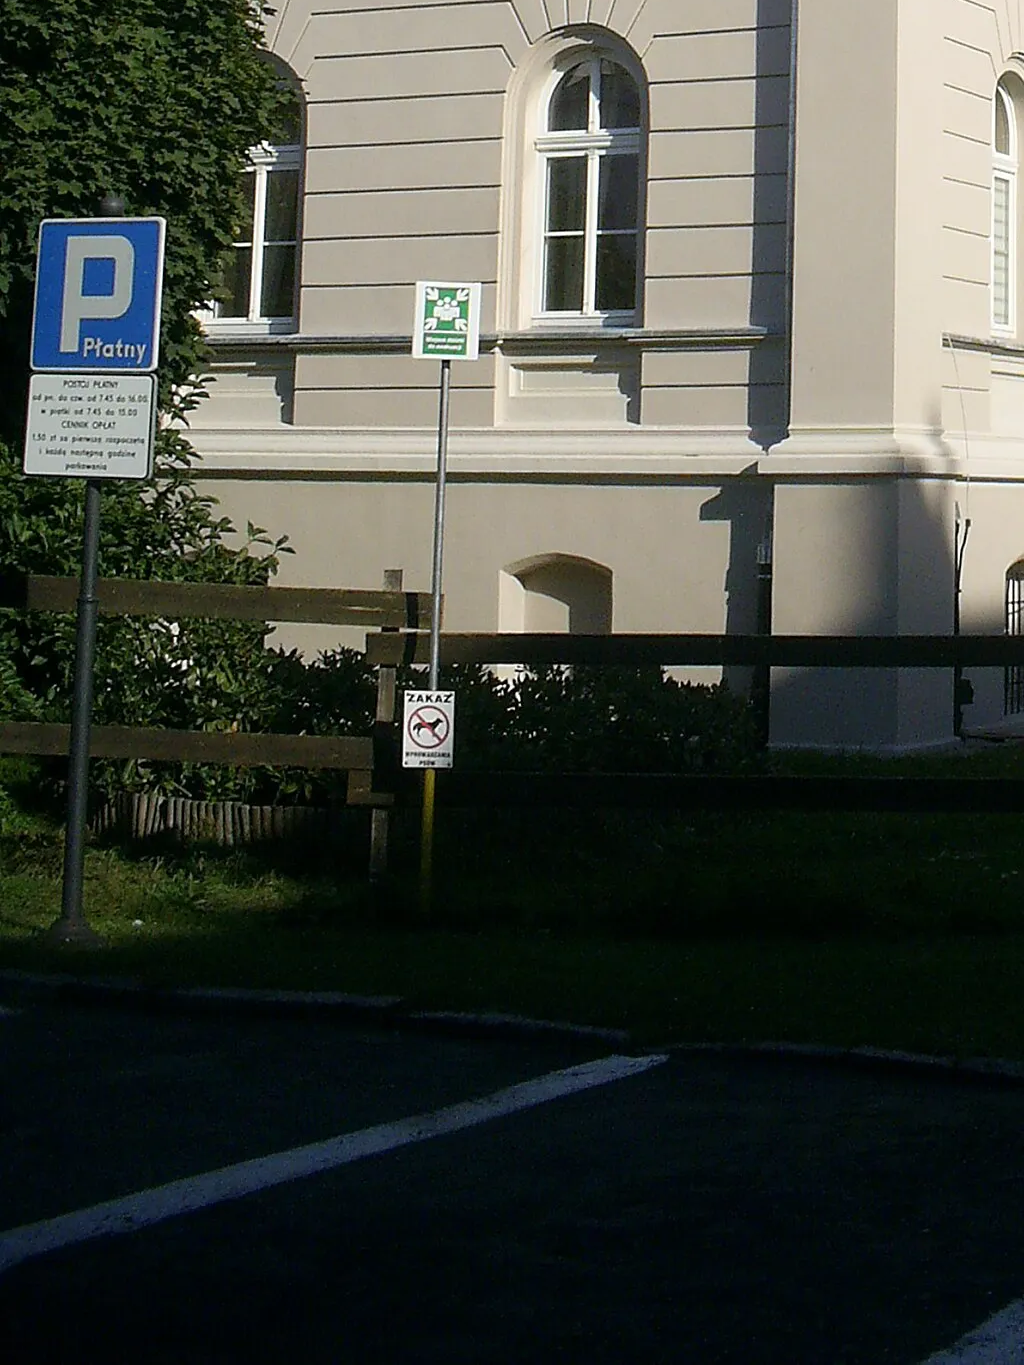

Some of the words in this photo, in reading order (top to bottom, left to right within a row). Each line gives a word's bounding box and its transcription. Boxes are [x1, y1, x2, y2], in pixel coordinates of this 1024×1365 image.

[59, 235, 135, 352] P
[83, 337, 147, 364] Płatny
[93, 380, 119, 389] PŁATNY
[61, 420, 88, 429] CENNIK
[92, 421, 116, 429] OPŁAT
[65, 462, 107, 471] parkowania
[407, 693, 453, 703] ZAKAZ
